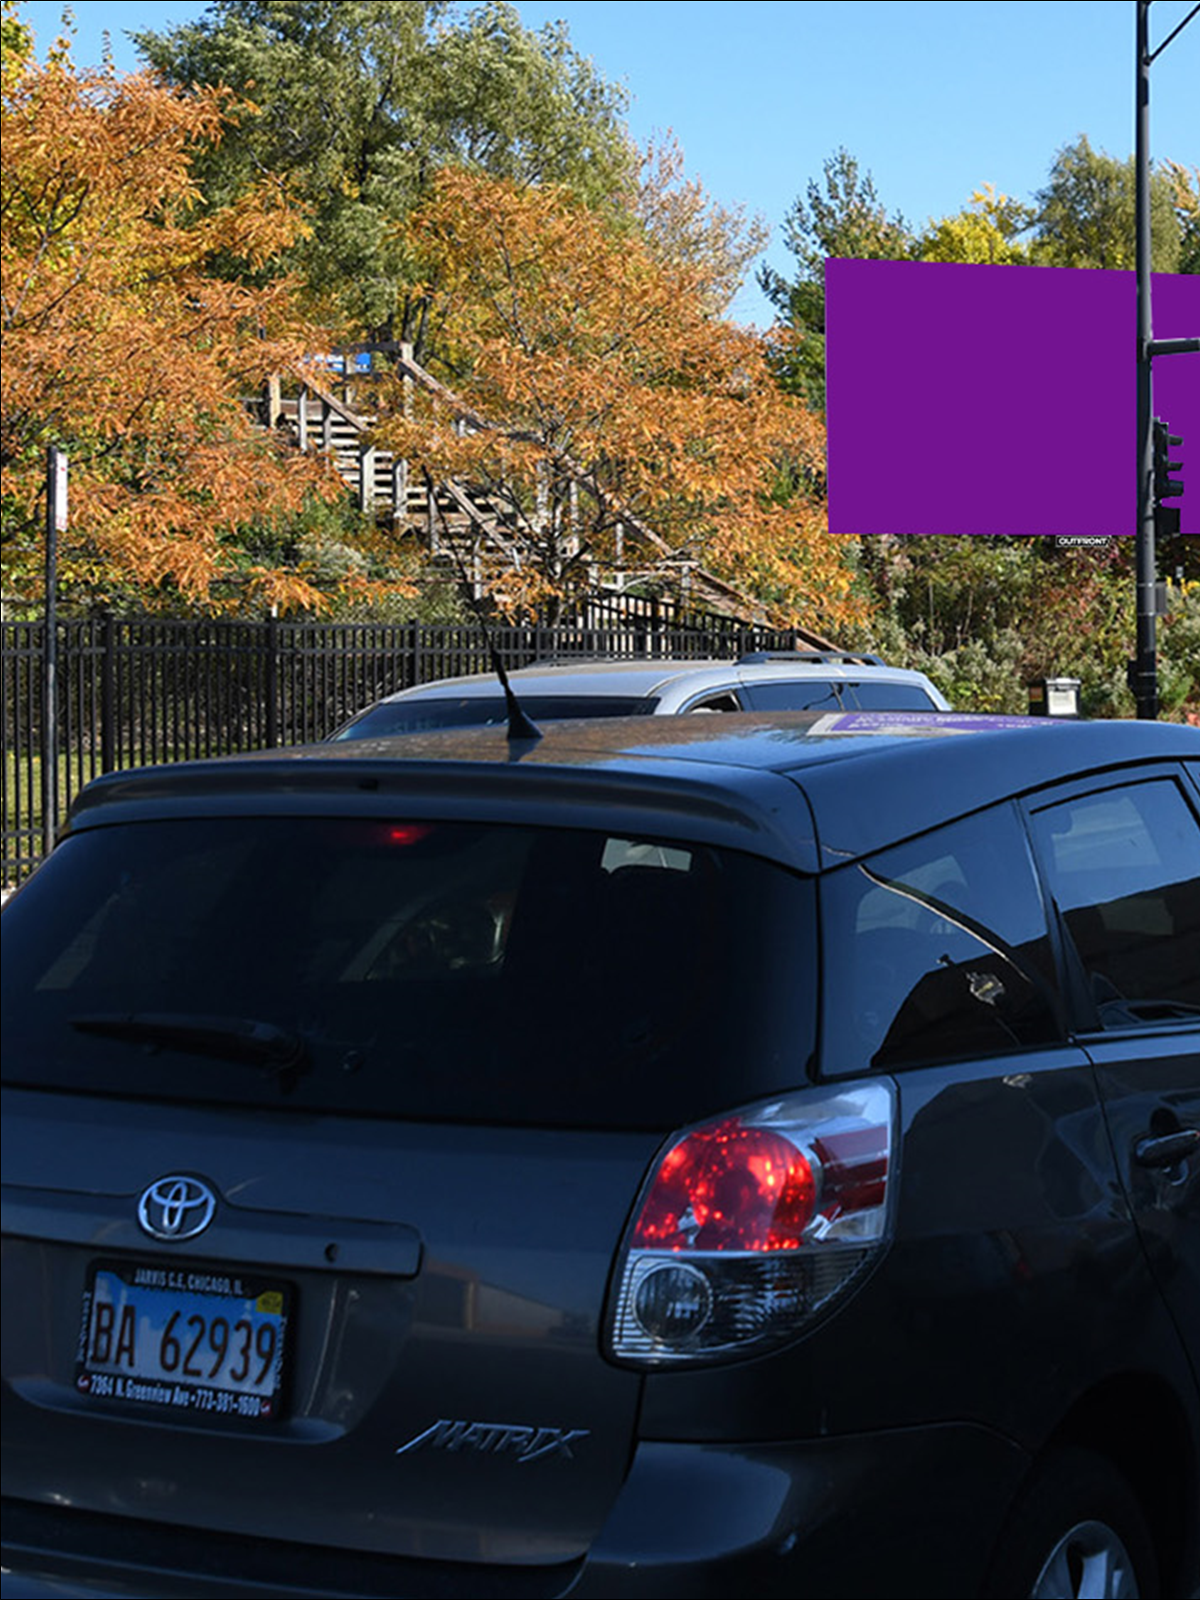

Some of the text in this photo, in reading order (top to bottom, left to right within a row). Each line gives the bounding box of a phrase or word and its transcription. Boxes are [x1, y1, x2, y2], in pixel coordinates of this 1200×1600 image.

[1058, 537, 1107, 545] OUTFRONT
[91, 1302, 136, 1368] BA
[159, 1310, 277, 1385] 62939
[395, 1419, 591, 1462] MATRIX
